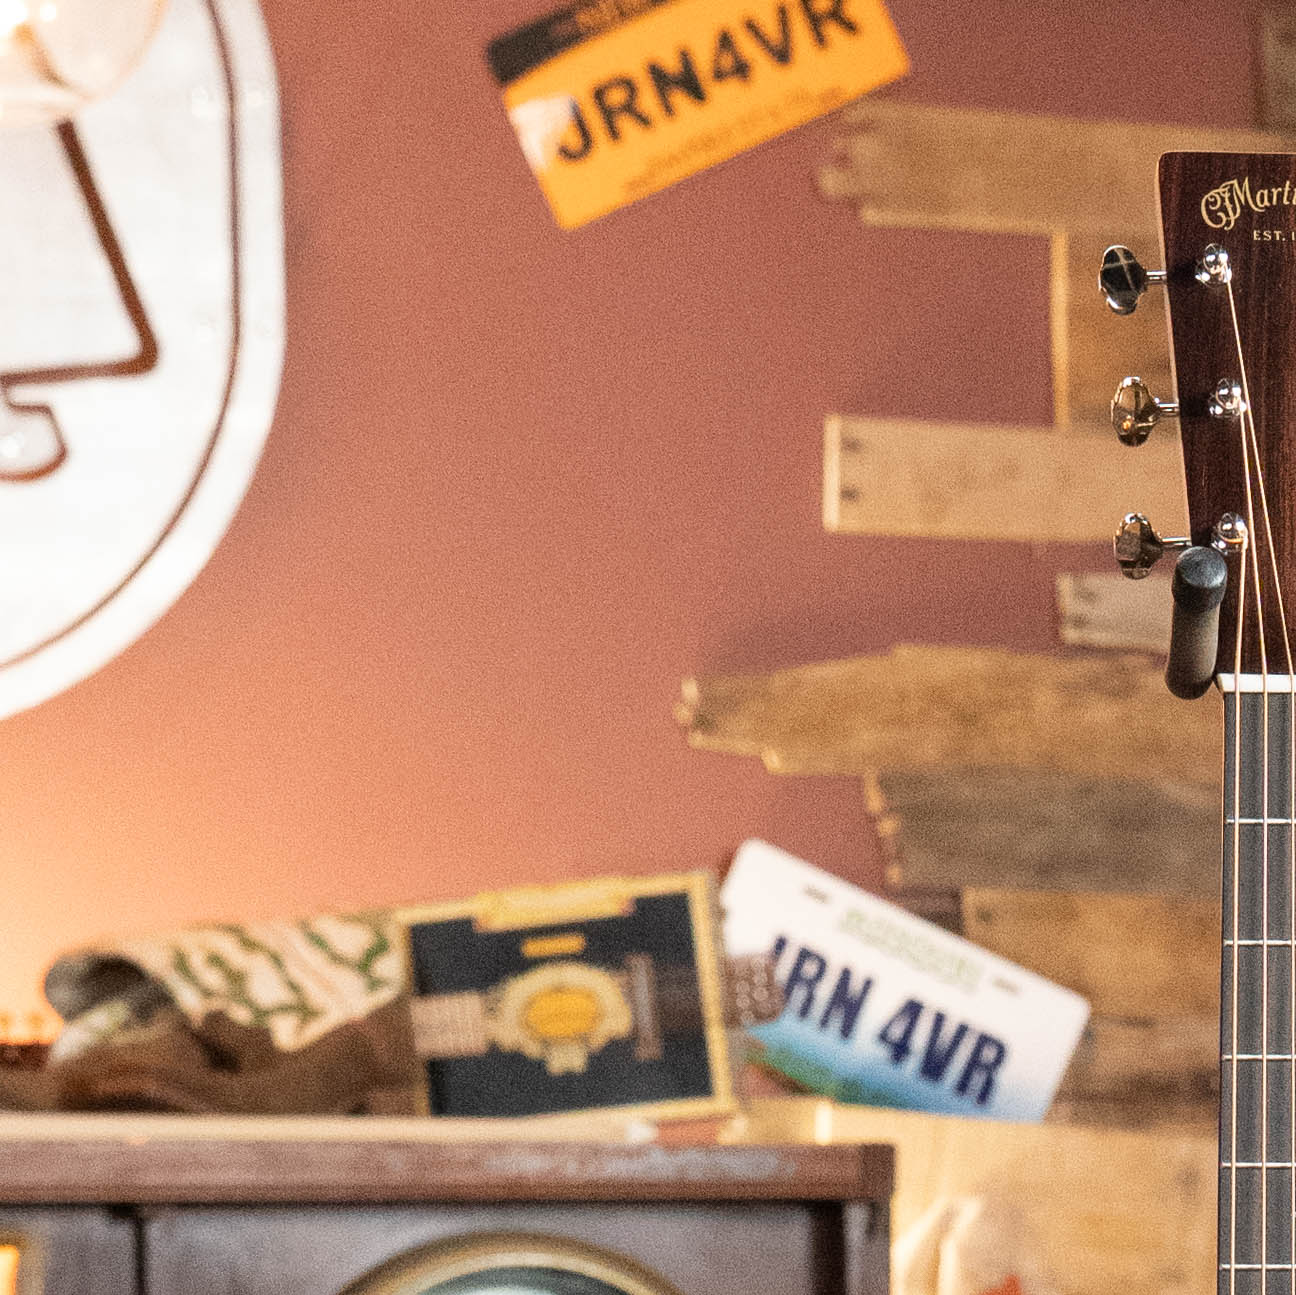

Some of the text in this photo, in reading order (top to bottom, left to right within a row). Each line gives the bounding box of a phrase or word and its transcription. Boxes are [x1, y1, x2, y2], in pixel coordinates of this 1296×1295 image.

[557, 0, 860, 162] JRN4VR
[1252, 229, 1286, 242] EST.
[877, 997, 1007, 1106] 4VR
